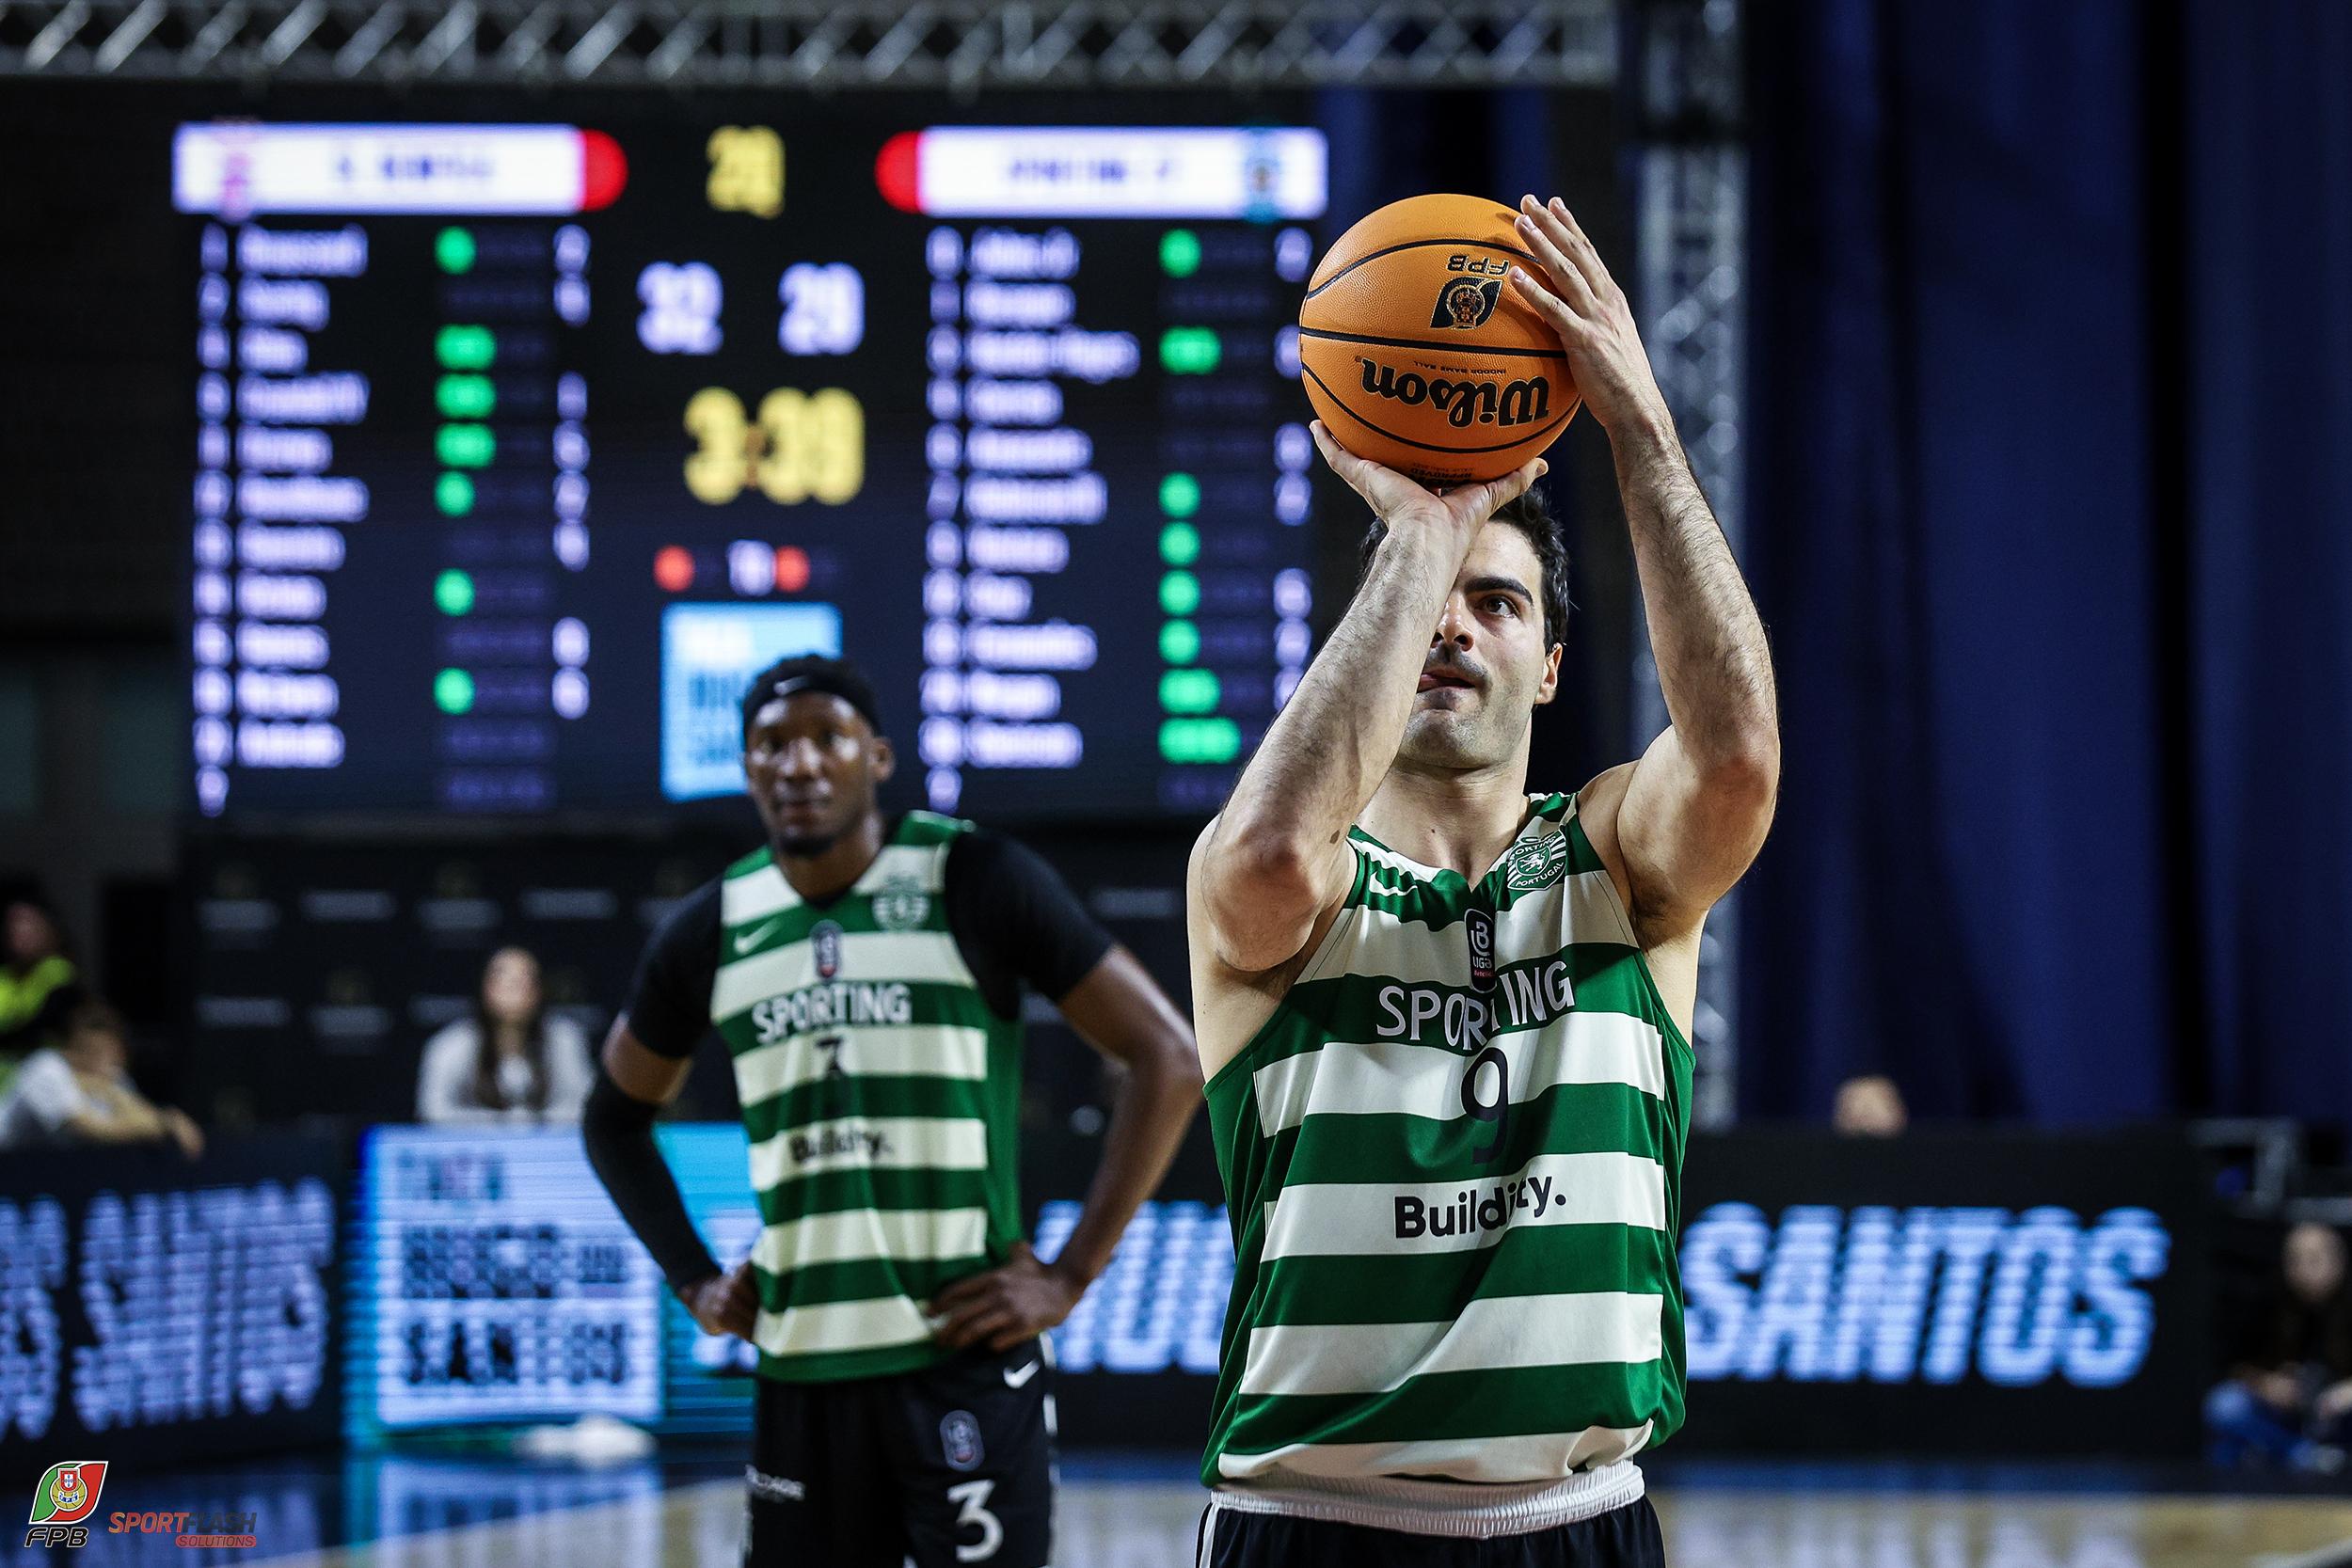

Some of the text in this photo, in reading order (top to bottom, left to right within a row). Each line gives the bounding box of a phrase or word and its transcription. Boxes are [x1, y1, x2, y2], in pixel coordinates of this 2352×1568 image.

[1447, 255, 1510, 277] FPB
[1361, 356, 1551, 429] Wilson
[1413, 359, 1437, 371] BALL
[1515, 862, 1564, 887] PORTUGAL
[753, 982, 913, 1044] SPORTING
[1461, 1047, 1508, 1164] 9
[1682, 1200, 2170, 1388] SANTOS
[946, 1479, 1004, 1563] 3
